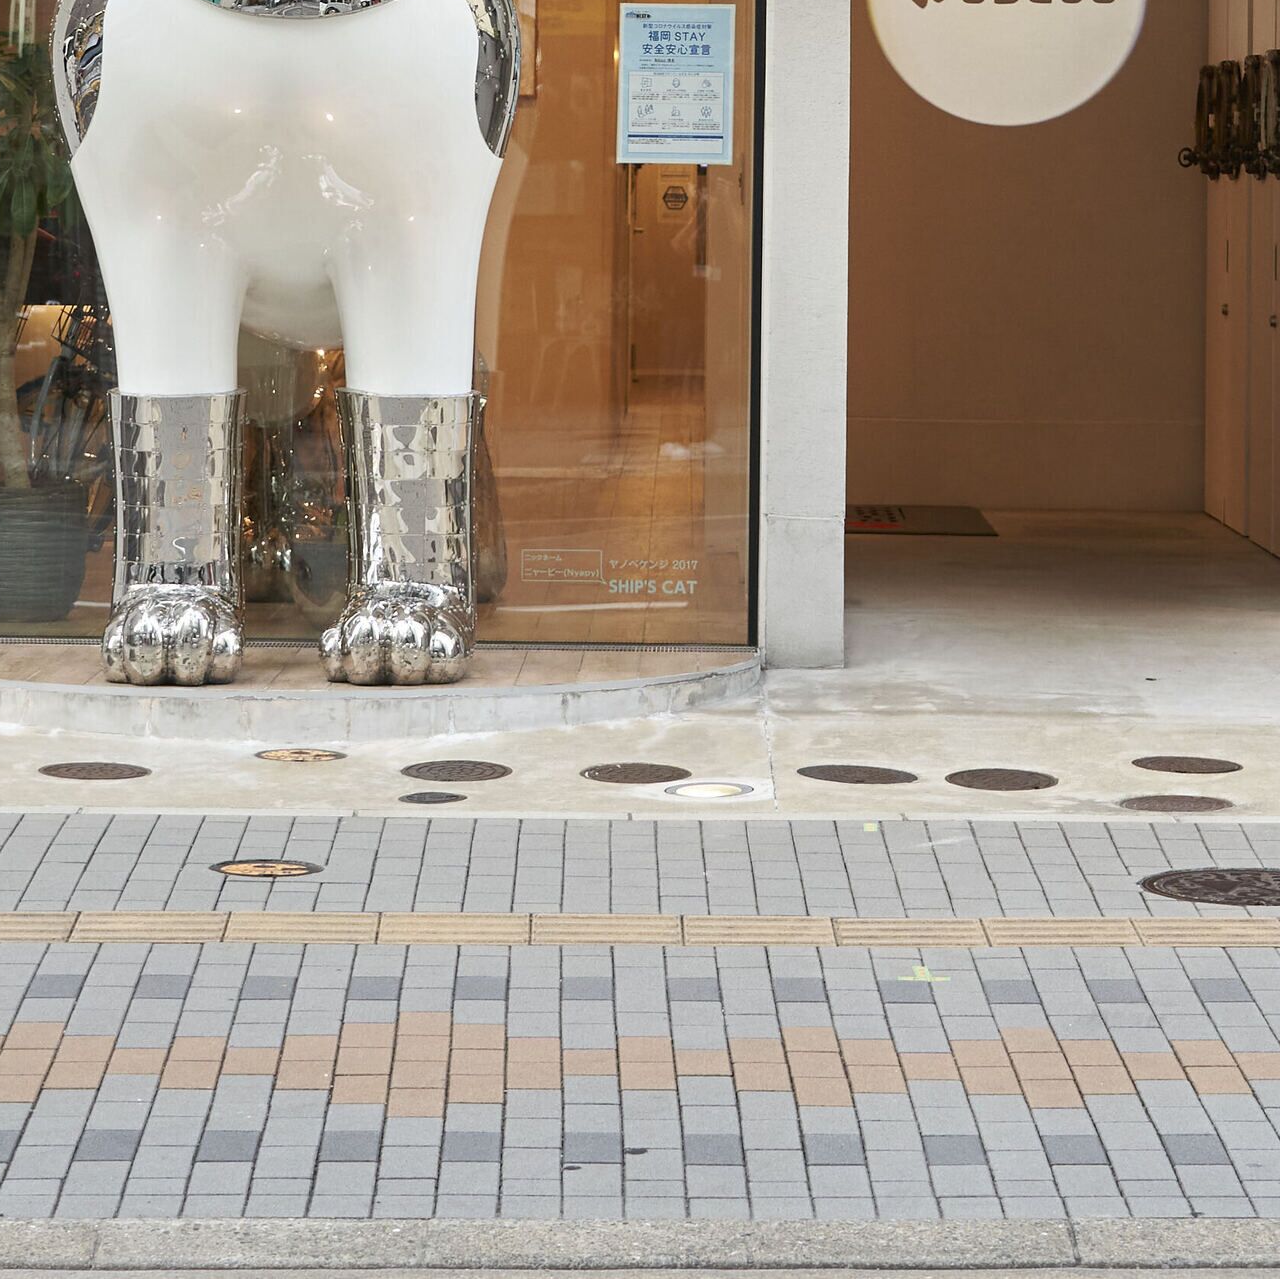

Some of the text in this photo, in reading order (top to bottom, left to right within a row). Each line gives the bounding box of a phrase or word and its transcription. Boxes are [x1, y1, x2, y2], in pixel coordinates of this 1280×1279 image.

[648, 31, 706, 42] 福岡 STAY
[642, 44, 712, 56] 安全安心宣言
[609, 560, 698, 570] ヤノベケンジ 2017
[609, 579, 698, 594] SHIP'S CAT
